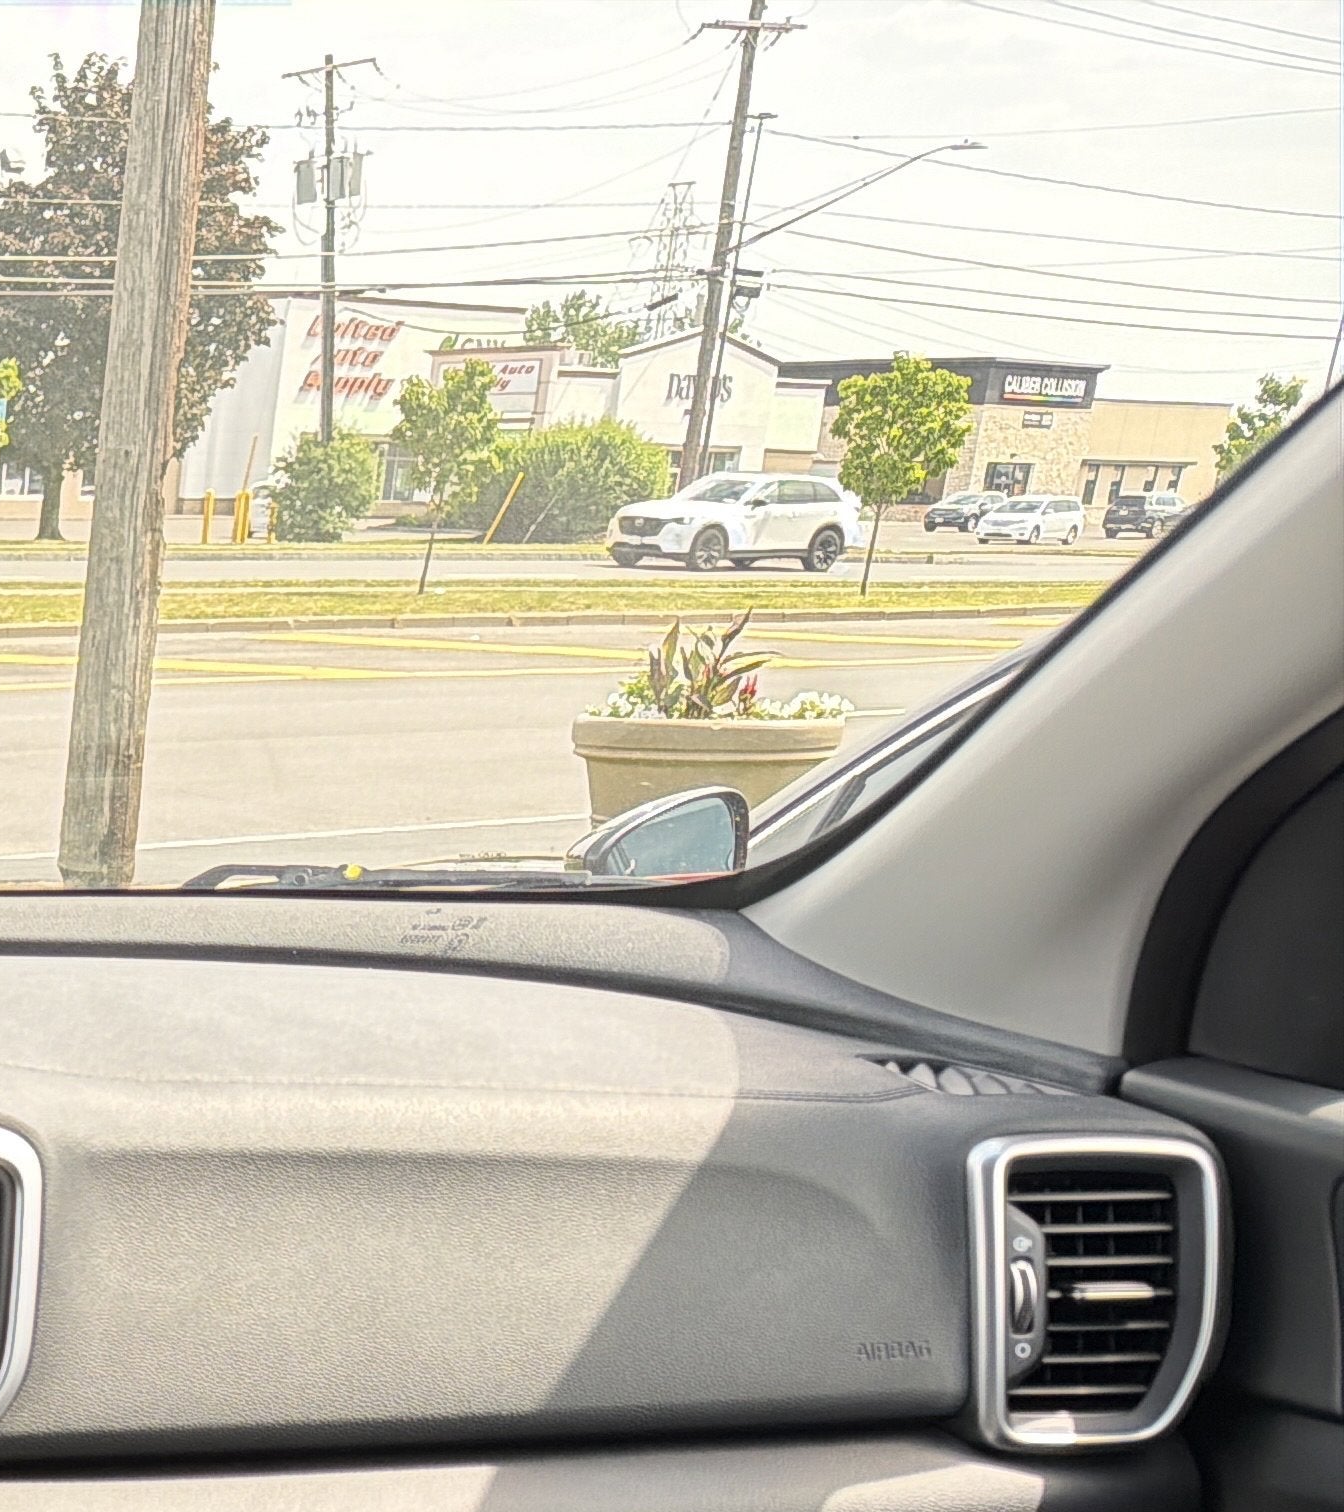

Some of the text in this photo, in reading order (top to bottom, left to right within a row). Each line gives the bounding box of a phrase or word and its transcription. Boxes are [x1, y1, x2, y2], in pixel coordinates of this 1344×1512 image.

[498, 364, 535, 375] Auto
[299, 370, 395, 401] Spply
[1004, 374, 1087, 398] CALIBER COLLISION
